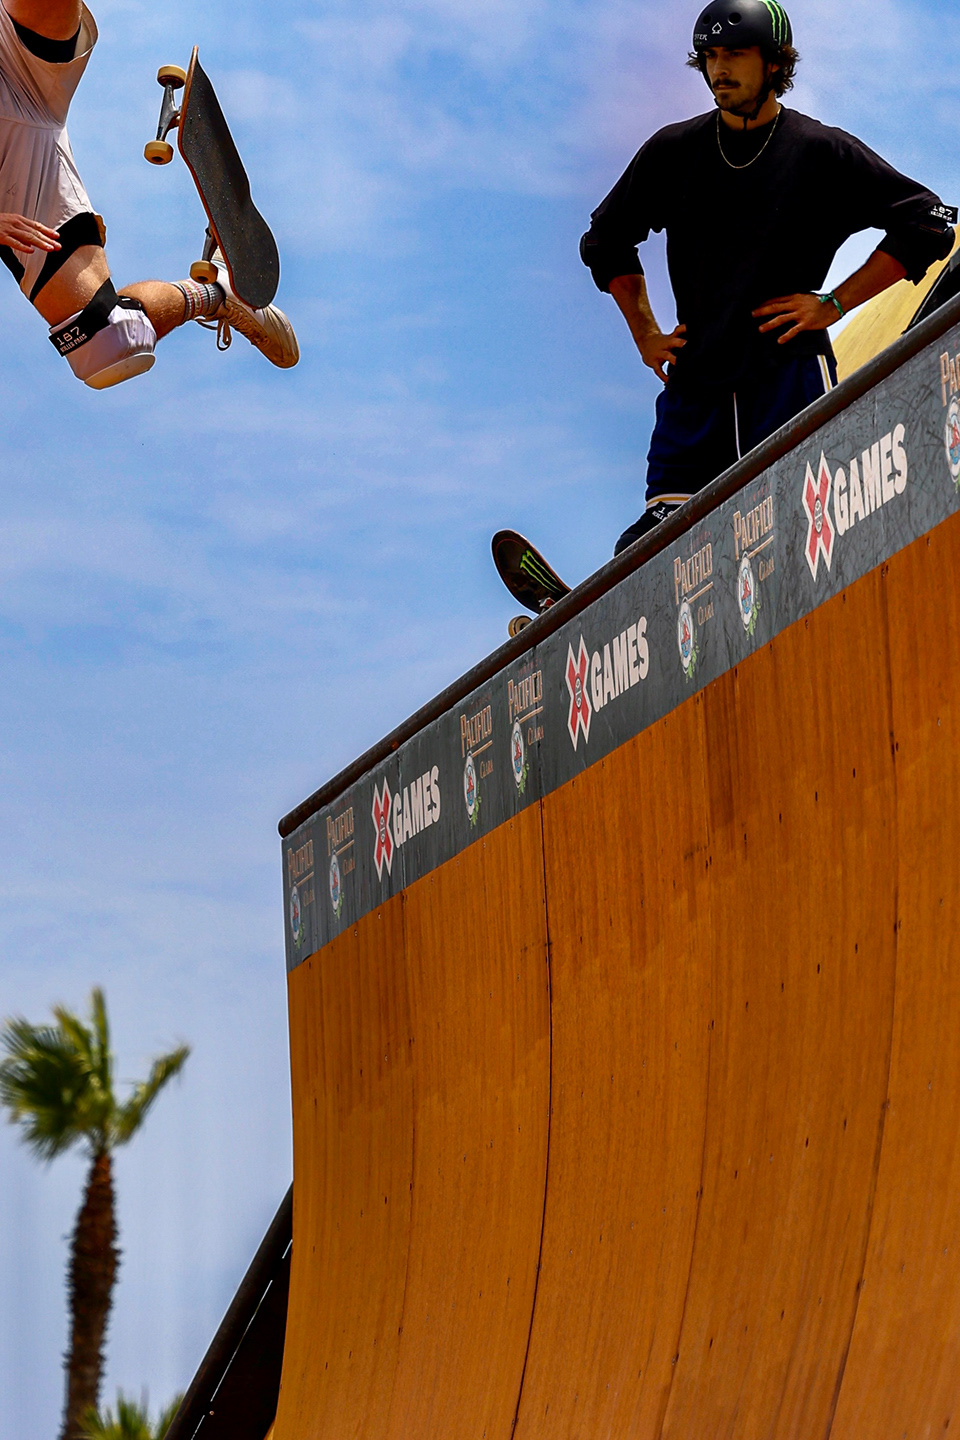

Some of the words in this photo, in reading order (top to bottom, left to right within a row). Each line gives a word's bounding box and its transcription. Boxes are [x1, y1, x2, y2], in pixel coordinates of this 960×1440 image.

[933, 205, 953, 216] 187
[56, 326, 80, 346] 187
[834, 423, 908, 536] GAMES
[733, 496, 774, 561] PACIFICO
[673, 543, 713, 606] PACIFICO
[591, 616, 649, 713] GAMES
[508, 670, 543, 725] PACIFICO
[460, 704, 492, 758] PACIFICO
[393, 765, 440, 849] GAMES
